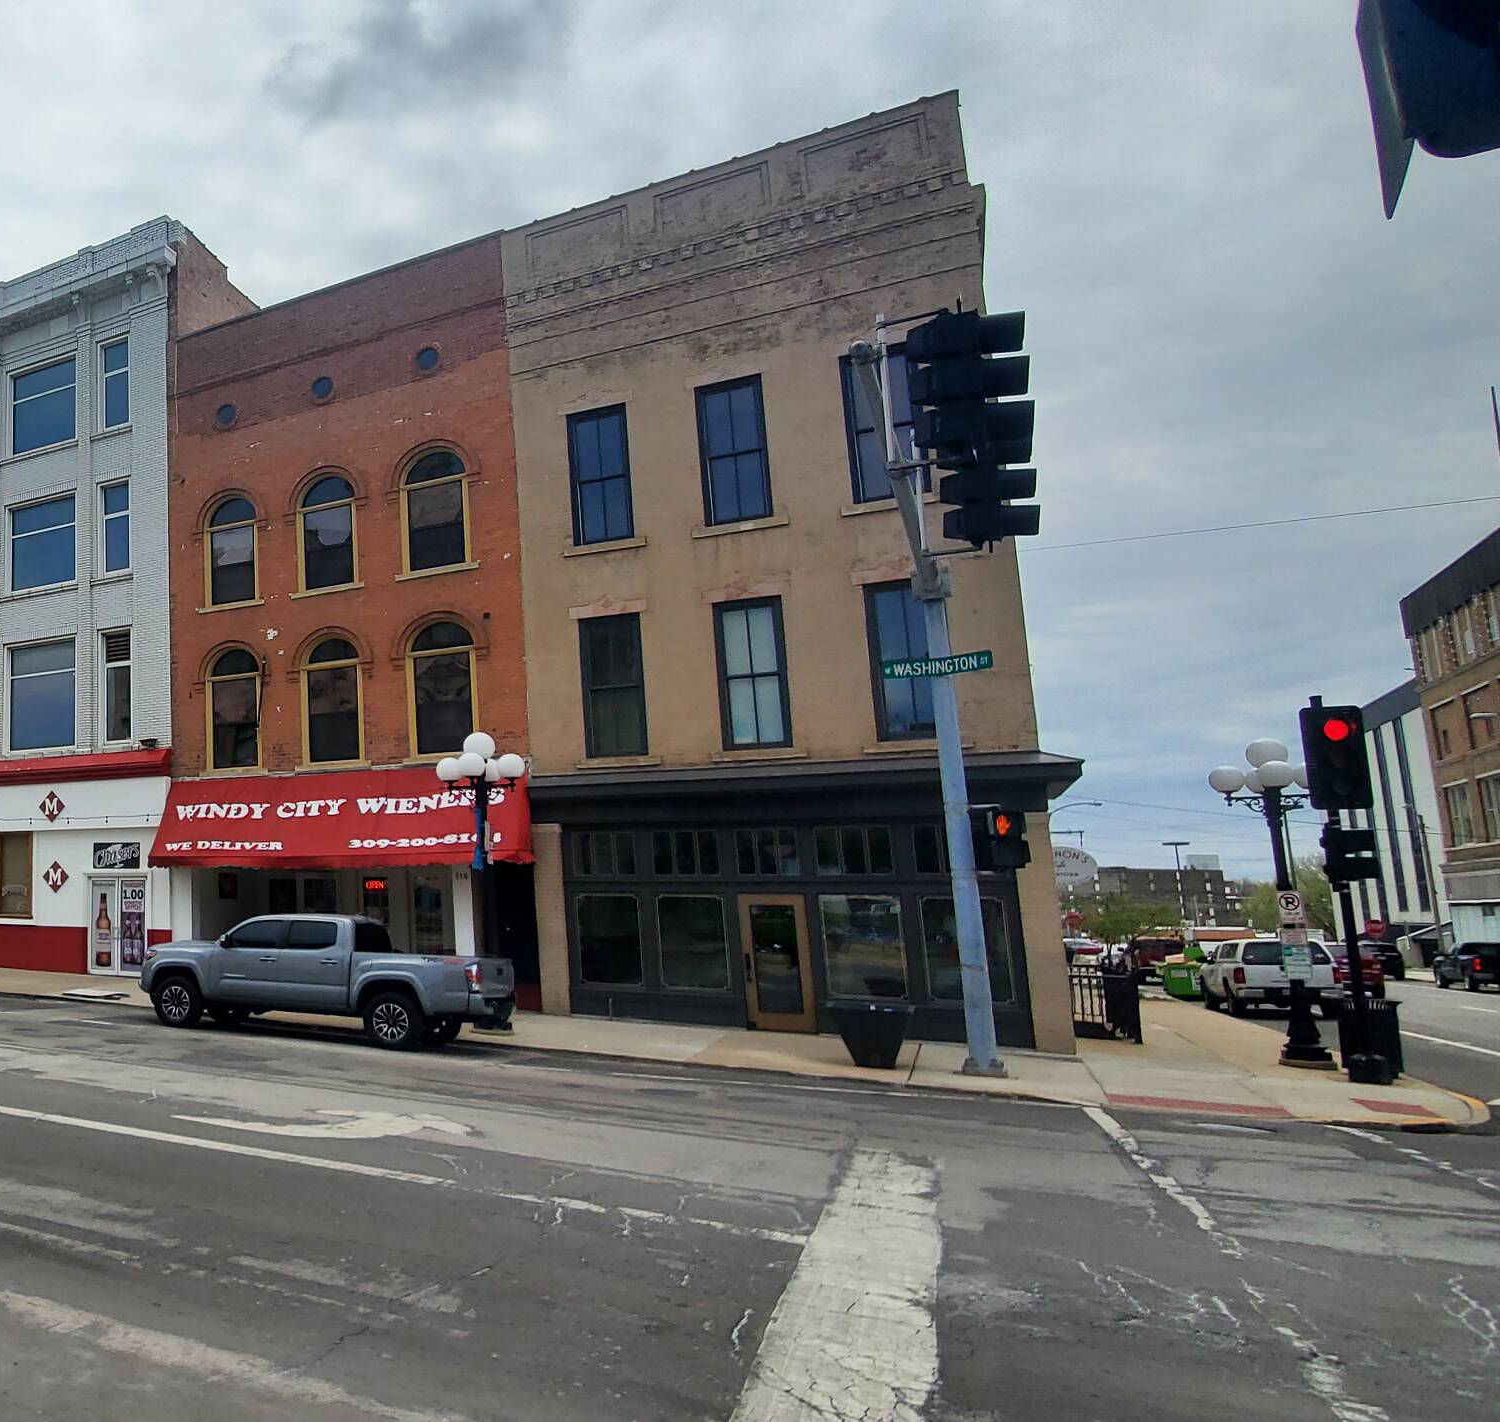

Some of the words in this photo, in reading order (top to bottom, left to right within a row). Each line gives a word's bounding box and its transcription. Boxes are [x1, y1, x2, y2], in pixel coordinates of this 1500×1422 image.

[893, 655, 978, 677] WASHINGTON
[980, 656, 989, 665] ST
[176, 803, 270, 821] WINDY
[276, 799, 347, 818] CITY
[165, 841, 193, 851] WE
[196, 840, 283, 850] DELIVER
[94, 843, 139, 868] Chasers
[365, 880, 384, 890] OPEN
[123, 889, 144, 900] 1.00
